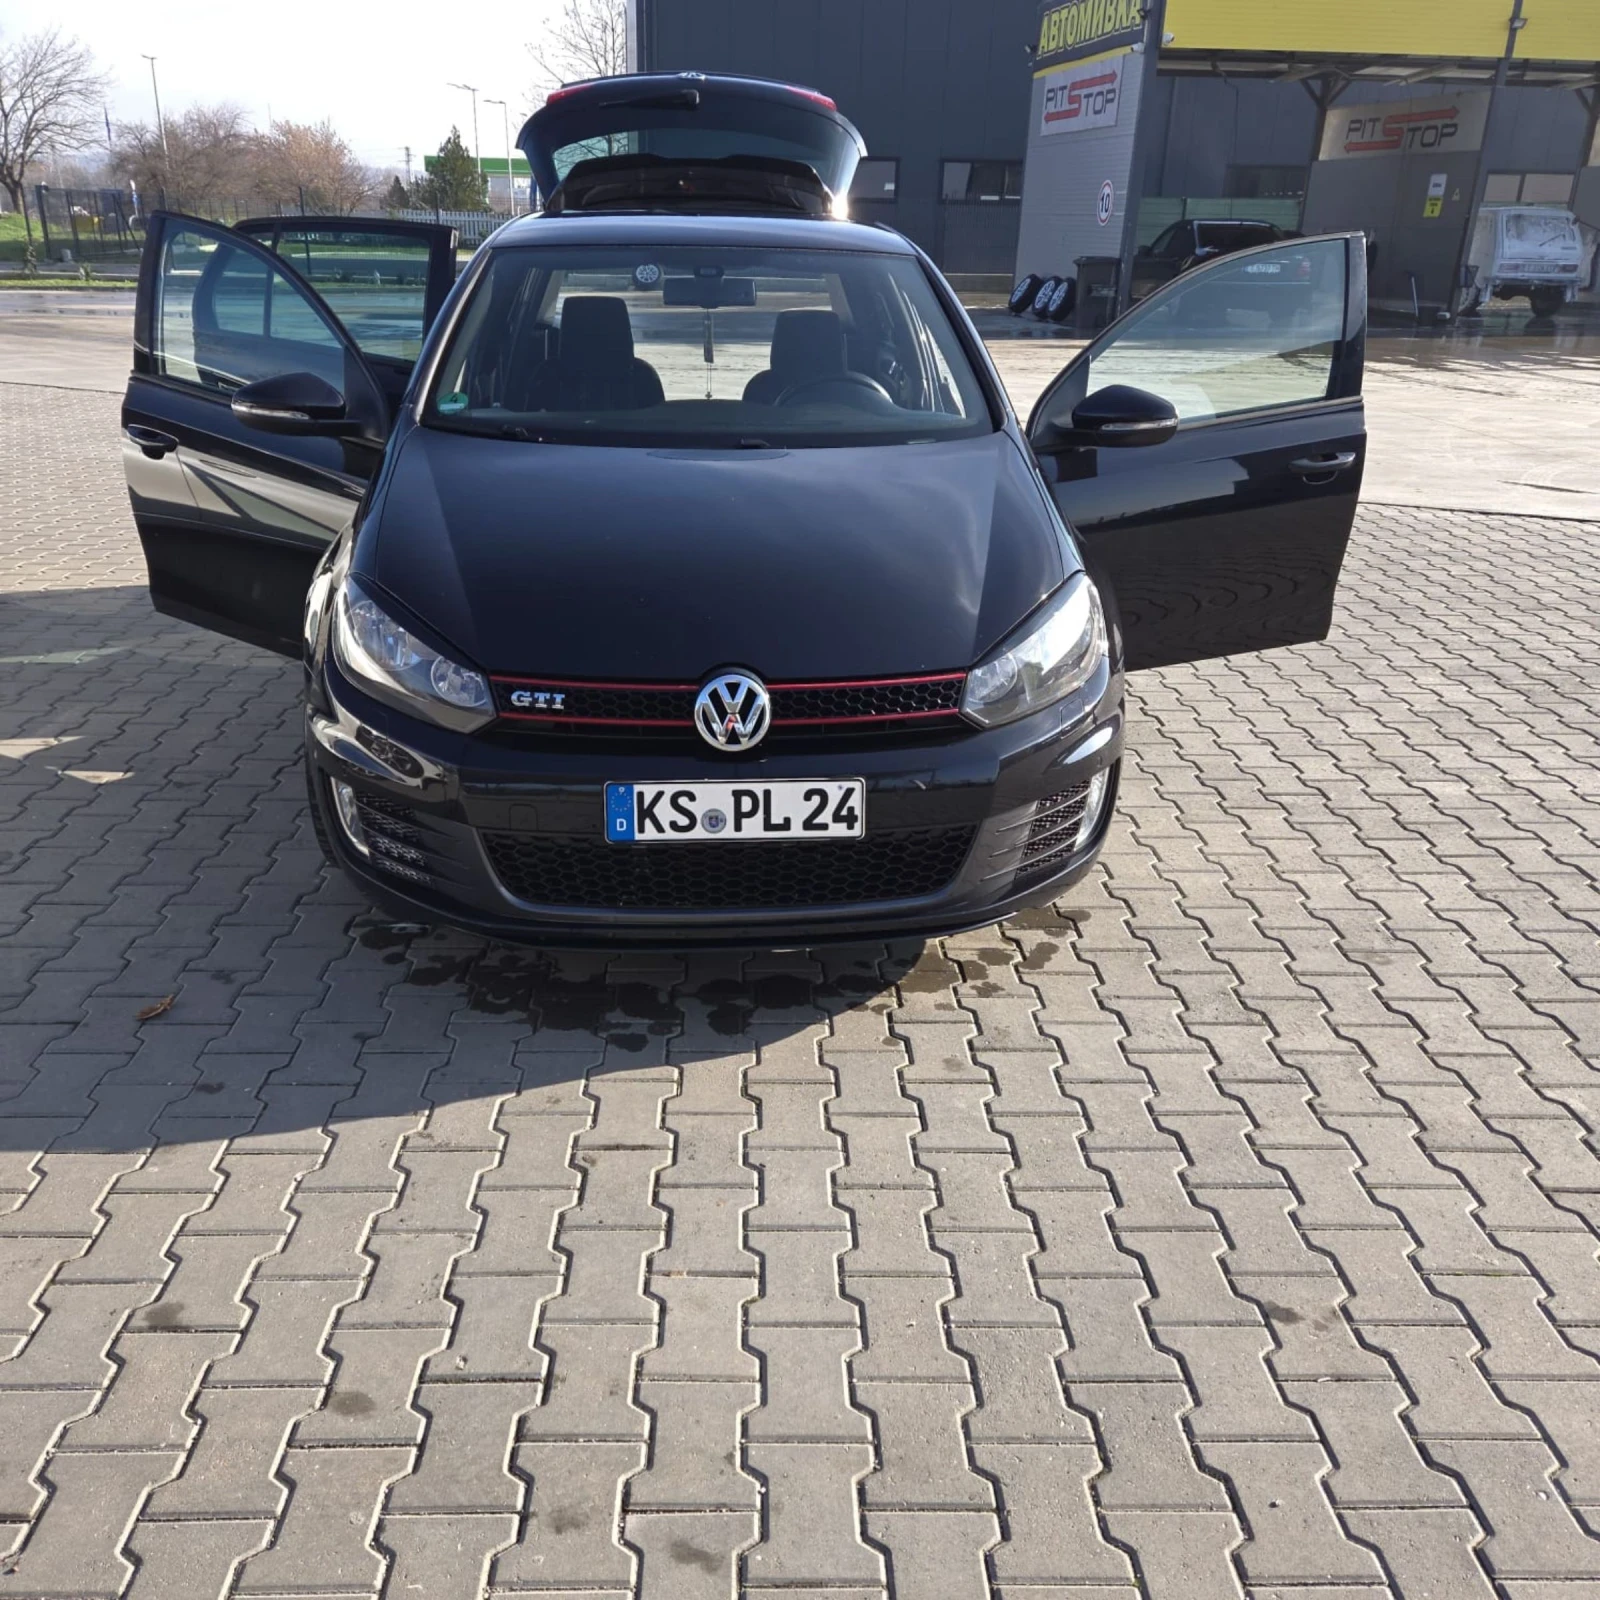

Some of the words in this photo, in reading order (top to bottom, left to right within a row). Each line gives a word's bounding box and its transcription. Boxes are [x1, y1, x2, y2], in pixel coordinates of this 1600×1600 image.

[1037, 0, 1142, 58] АВТОМИВКА
[1044, 85, 1068, 110] PIT
[1345, 117, 1381, 140] PIT
[1382, 115, 1458, 149] STOP
[1101, 192, 1111, 213] 10
[510, 690, 566, 710] GTI
[636, 789, 698, 834] KS
[731, 788, 792, 833] PL
[802, 787, 859, 831] 24
[616, 818, 627, 831] D
